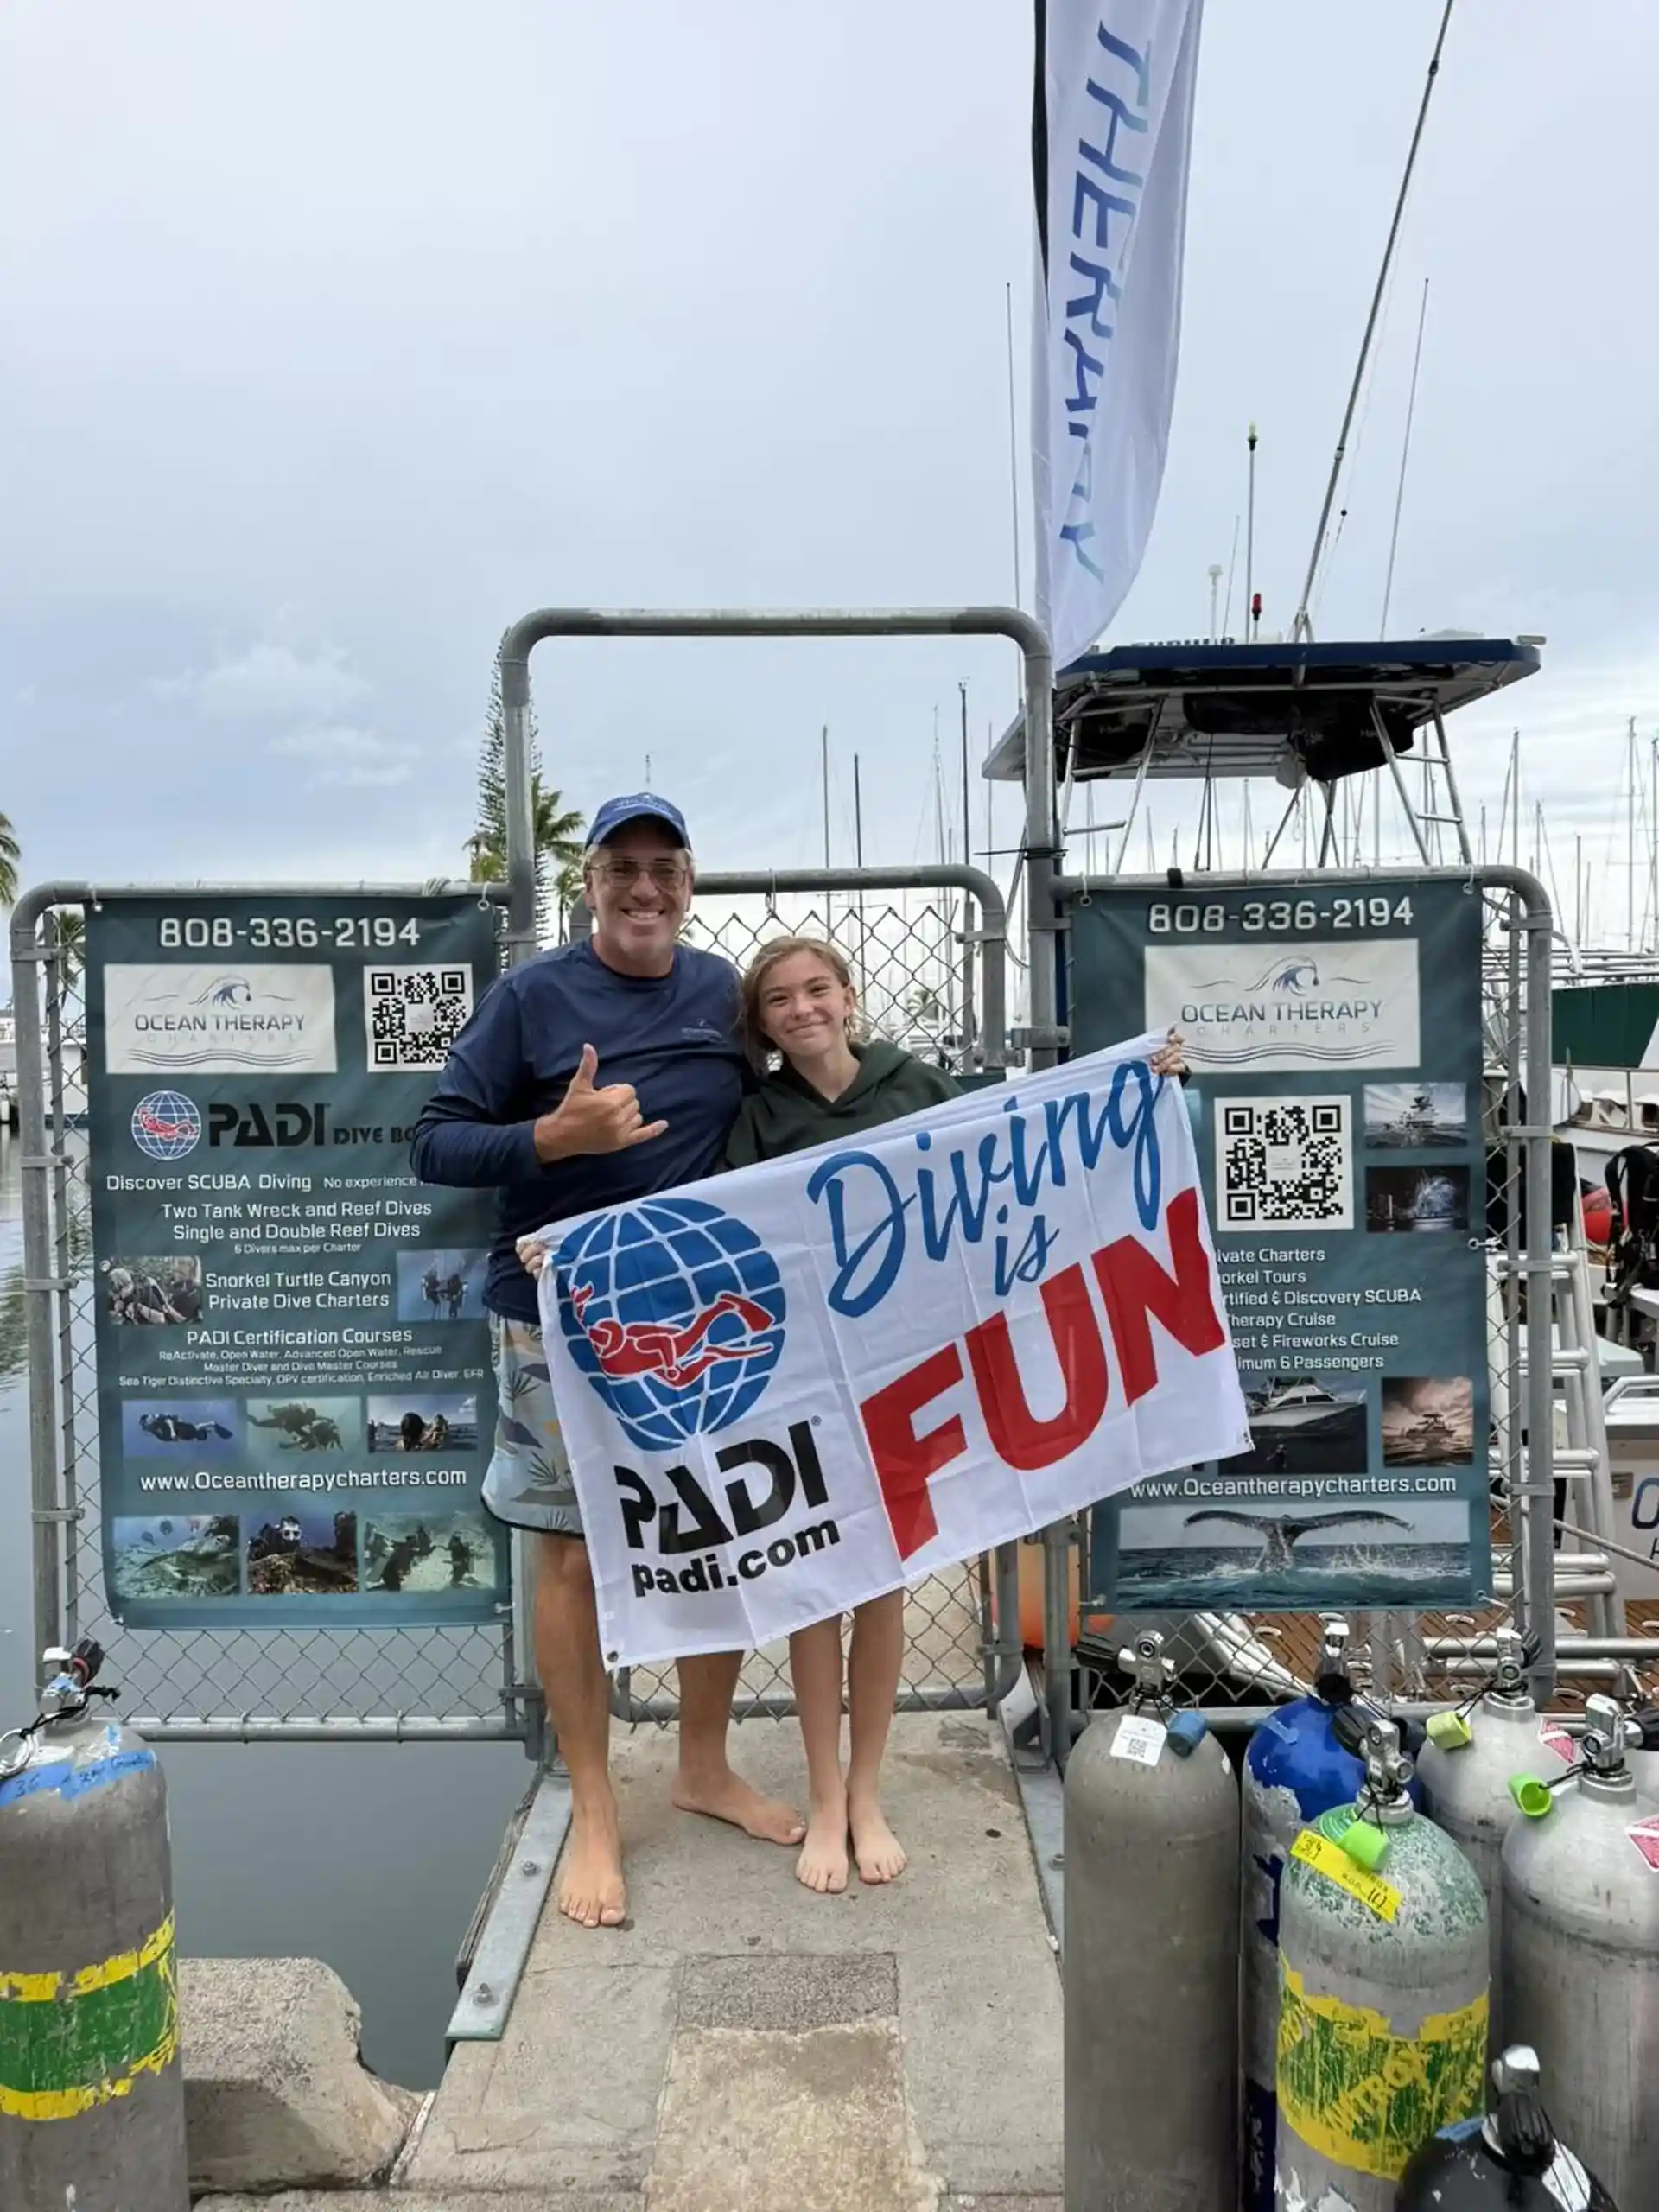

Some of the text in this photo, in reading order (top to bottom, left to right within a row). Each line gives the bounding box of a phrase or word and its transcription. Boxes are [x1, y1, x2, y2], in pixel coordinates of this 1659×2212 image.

[1149, 897, 1414, 933] 808-336-2194
[159, 917, 421, 948] 808-336-2194
[1181, 1000, 1383, 1023] OCEAN THERAPY
[134, 1014, 305, 1031] OCEAN THERAPY
[1196, 1022, 1370, 1037] CHARTERS
[208, 1103, 327, 1147] PADI
[334, 1126, 416, 1145] DIVE BO
[106, 1174, 312, 1192] Discover SCUBA Diving
[323, 1177, 342, 1188] No
[346, 1176, 417, 1189] experience
[805, 1059, 1166, 1318] Diving
[163, 1200, 432, 1219] Two Tank Wreck and Reef Dives
[173, 1222, 421, 1243] Single and Double Reef Dives
[234, 1242, 362, 1255] 6 Divers max per Charter
[995, 1205, 1063, 1298] is
[1217, 1248, 1325, 1262] ivate Charters
[206, 1271, 391, 1289] Snorkel Turtle Canyon
[1221, 1270, 1306, 1284] orkel Tours
[208, 1293, 390, 1310] Private Dive Charters
[1222, 1288, 1422, 1306] rtified & Discovery SCUBA
[1227, 1313, 1336, 1329] herapy Cruise
[188, 1328, 413, 1345] PADI Certification Courses
[1232, 1333, 1400, 1349] set & Fireworks Cruise
[220, 1350, 248, 1362] Open
[284, 1350, 336, 1359] Advanced
[338, 1349, 365, 1359] Open
[403, 1346, 442, 1356] Rescue
[1238, 1354, 1385, 1370] imum 6 Passengers
[204, 1360, 397, 1372] Master Diver and Dive Master Courses
[859, 1186, 1226, 1561] FUN
[119, 1376, 139, 1387] Sea
[142, 1376, 166, 1388] Tiger
[168, 1376, 223, 1385] Distinctive
[367, 1372, 413, 1382] Enriched
[415, 1370, 430, 1380] Air
[464, 1369, 484, 1379] EFR
[140, 1468, 467, 1492] www.Oceantherapycharters.com
[613, 1418, 831, 1554] PADI
[1129, 1476, 1457, 1499] www.Oceantherapycharters.com
[631, 1516, 841, 1598] padi.com
